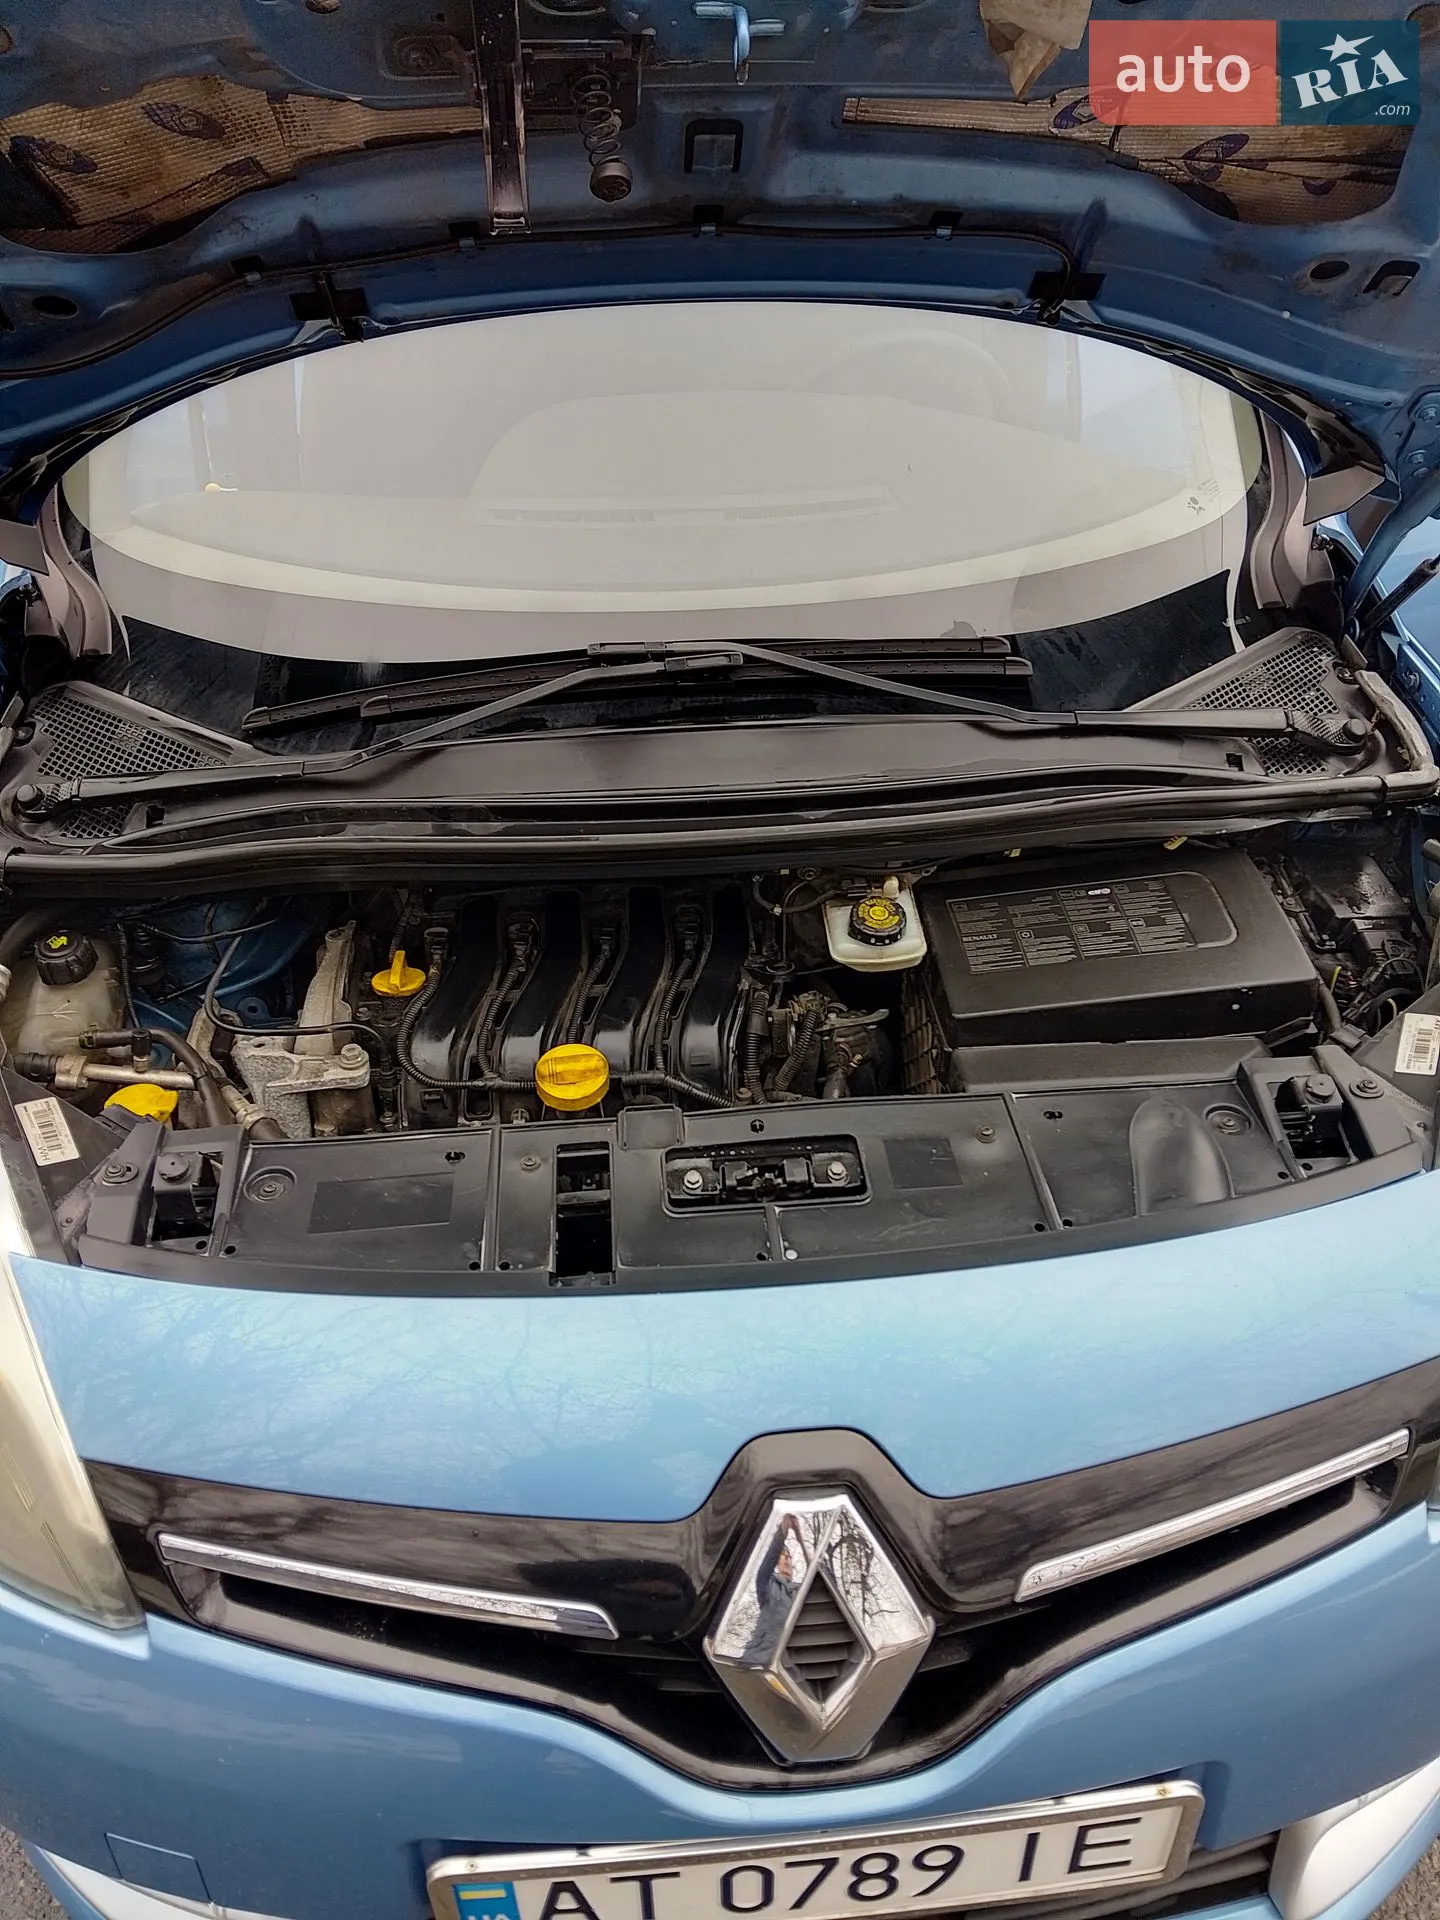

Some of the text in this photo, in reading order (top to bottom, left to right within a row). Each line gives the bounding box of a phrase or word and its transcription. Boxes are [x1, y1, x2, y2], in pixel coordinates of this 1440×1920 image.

[962, 934, 998, 942] RENAULT
[540, 1817, 1142, 1920] AT 0789 IE
